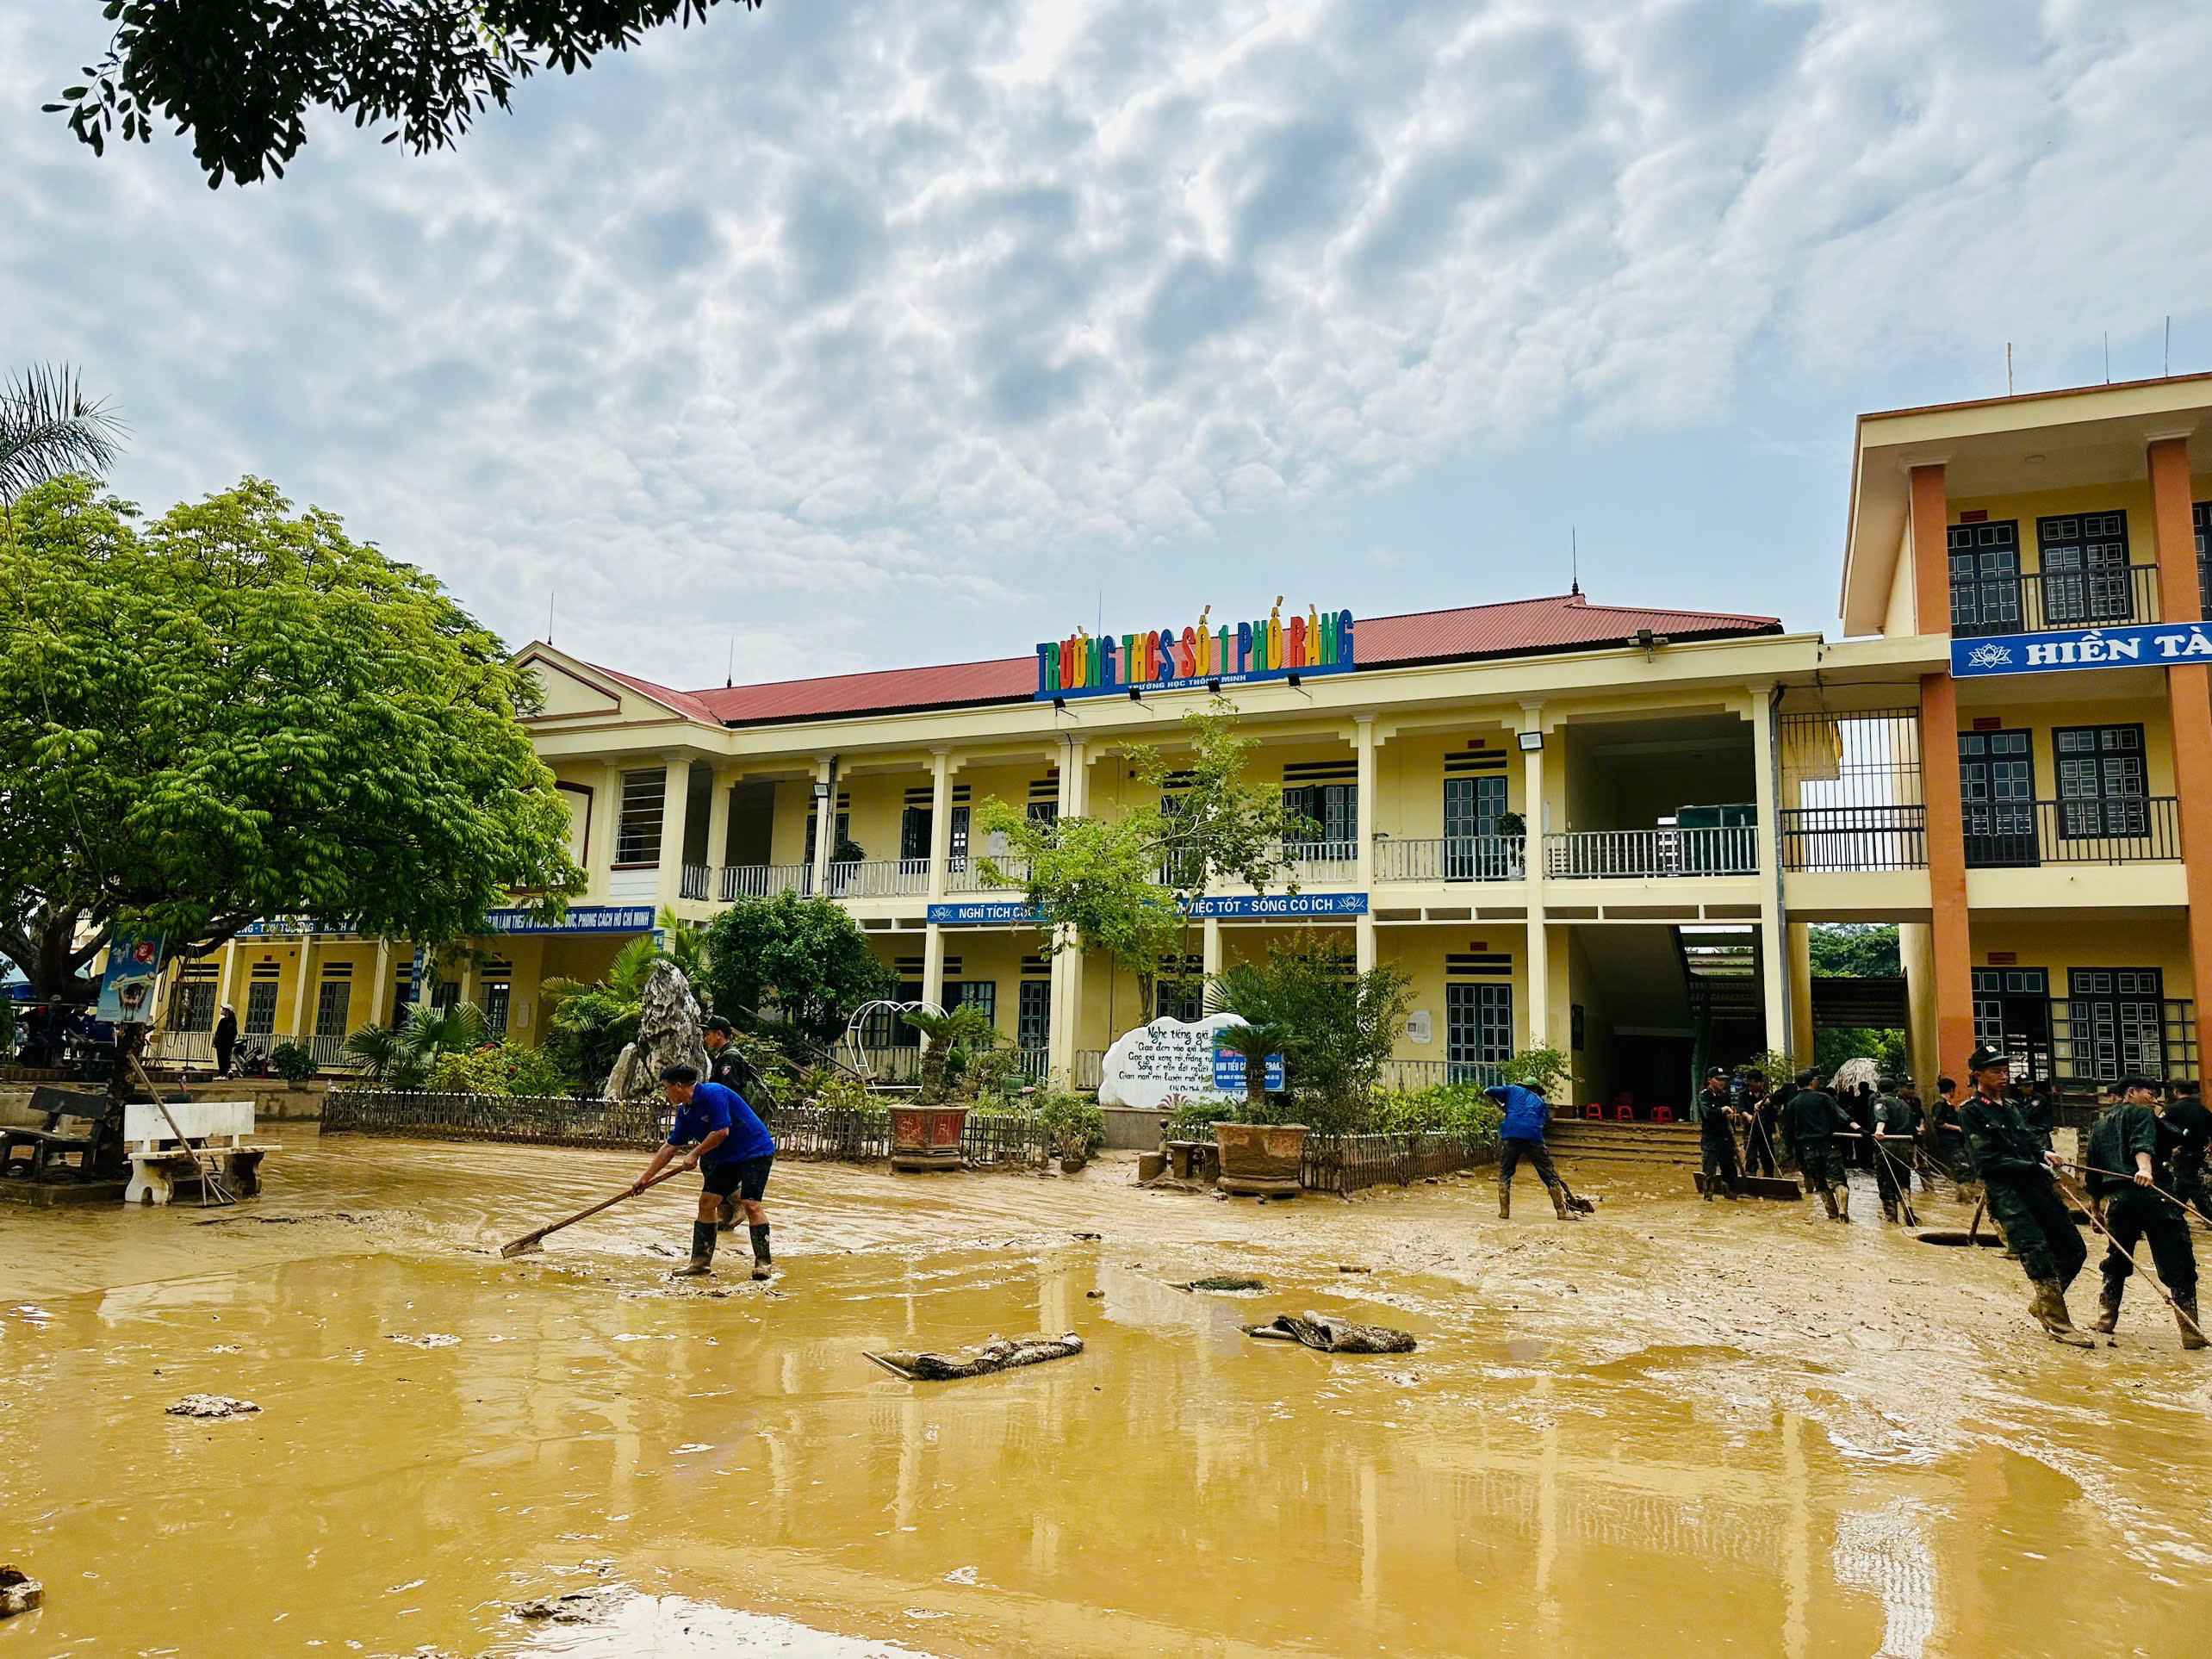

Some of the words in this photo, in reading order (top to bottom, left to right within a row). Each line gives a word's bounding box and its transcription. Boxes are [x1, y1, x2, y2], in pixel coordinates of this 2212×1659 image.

[1036, 625, 1116, 691] TRƯỜNG
[1122, 629, 1174, 684] THCS
[1182, 605, 1211, 679] SỐ
[1219, 625, 1228, 674] 1
[1238, 596, 1284, 673] PHỐ
[1290, 604, 1355, 668] RÀNG
[2025, 630, 2141, 666] HIỀN
[1167, 680, 1185, 688] HỌC
[1221, 674, 1246, 683] MINH
[959, 904, 985, 919] NGHĨ
[986, 904, 1010, 918] TÍCH
[1216, 896, 1240, 913] TỐT
[1251, 897, 1286, 912] SỐNG
[1289, 896, 1308, 911] CÓ
[1311, 896, 1333, 910] ÍCH
[578, 912, 597, 928] PHONG
[597, 910, 613, 928] CÁCH
[623, 909, 633, 927] CHÍ
[633, 911, 649, 926] MINH
[1148, 1026, 1167, 1044] Nghe
[1215, 1061, 1227, 1072] KHU
[1119, 1071, 1134, 1080] Gian
